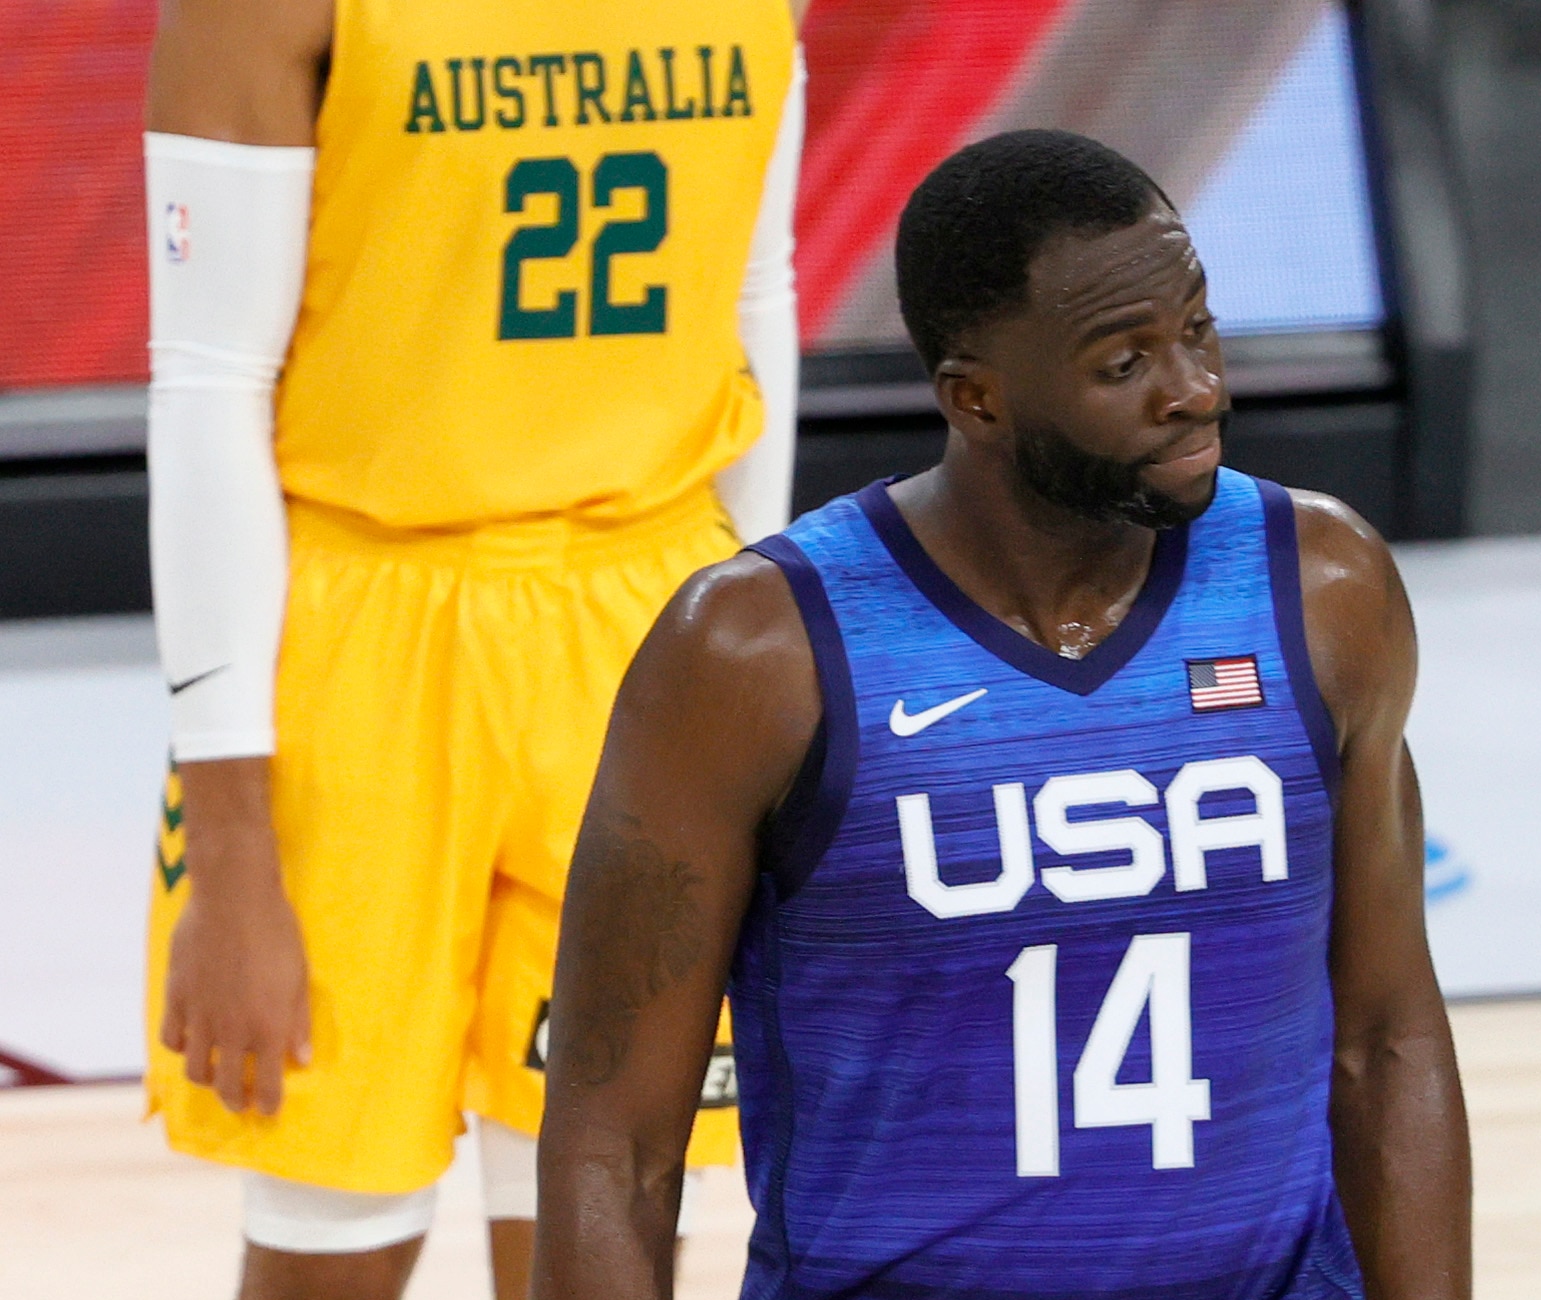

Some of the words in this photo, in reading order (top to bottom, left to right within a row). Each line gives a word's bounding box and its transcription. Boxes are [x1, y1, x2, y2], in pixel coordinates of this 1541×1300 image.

[404, 44, 753, 134] AUSTRALIA
[496, 150, 668, 342] 22
[895, 755, 1289, 919] USA
[1004, 932, 1212, 1178] 14
